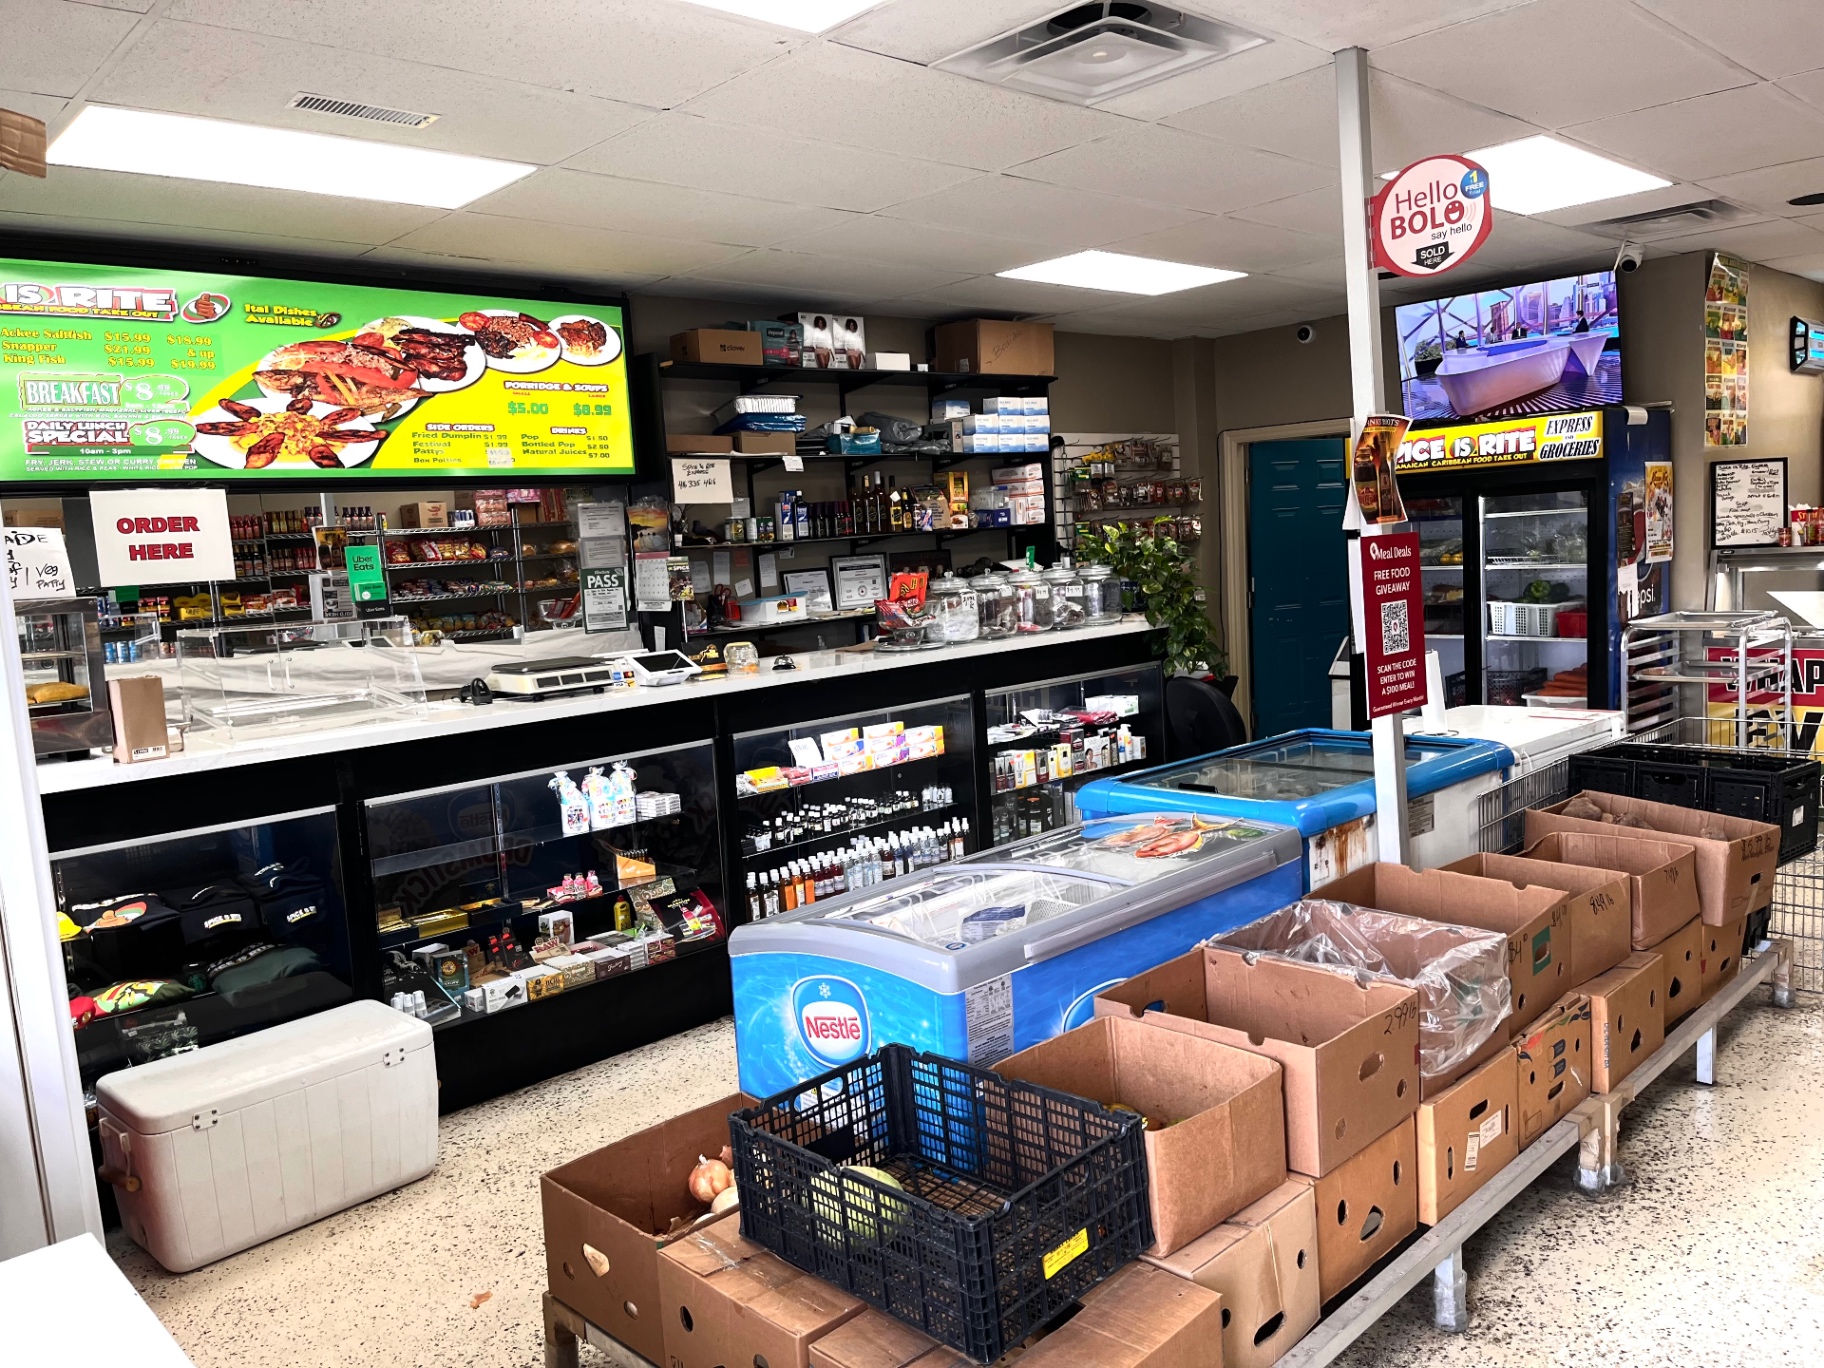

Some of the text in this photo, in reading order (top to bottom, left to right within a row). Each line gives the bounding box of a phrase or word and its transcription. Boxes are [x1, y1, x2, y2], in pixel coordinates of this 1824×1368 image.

[1469, 171, 1479, 183] 1
[1465, 181, 1484, 192] FREE
[1396, 180, 1458, 214] Hello
[1391, 200, 1465, 240] BOLO
[1431, 222, 1473, 241] say hello
[1420, 245, 1446, 260] SOLD
[1424, 256, 1442, 266] HERE
[5, 284, 174, 312] IS RITE
[48, 306, 159, 319] FOOD TAKE OUT
[245, 303, 317, 318] Ital Dishes
[245, 314, 314, 328] Available
[1, 328, 213, 347] Ackee Saltfish $15.99 $18.99
[2, 341, 215, 361] Snapper $21.99 & up
[4, 354, 217, 371] King Fish $15.99 $19.99
[25, 380, 120, 405] BREAKFAST
[504, 381, 561, 392] PORRIDGE
[574, 384, 609, 393] SOUPS
[507, 401, 549, 415] $5.00
[27, 421, 126, 431] DAILY LUNCH
[426, 423, 494, 432] SIDE ORDERS
[1545, 416, 1594, 436] EXPRESS
[28, 430, 128, 443] SPECIAL
[411, 432, 438, 440] Fried
[441, 432, 483, 441] Dumplin
[112, 448, 131, 456] 3pm
[413, 448, 445, 456] Pattys
[1396, 428, 1537, 463] ICE IS RITE
[1539, 438, 1600, 461] GROCERIES
[1431, 457, 1474, 468] CARIBBEAN
[1473, 456, 1493, 464] FOOD
[1493, 454, 1513, 463] TAKE
[1513, 453, 1528, 461] OUT
[116, 516, 201, 534] ORDER
[128, 542, 194, 561] HERE
[352, 555, 373, 563] Uber
[1377, 545, 1412, 561] Meal Deals
[353, 563, 375, 571] Eats
[1374, 566, 1411, 581] FREE FOOD
[587, 574, 619, 589] PASS
[1375, 580, 1411, 596] GIVEAWAY
[1377, 657, 1418, 675] SCAN THE CODE
[1380, 669, 1416, 685] ENTER TO WIN
[1381, 686, 1387, 696] A
[535, 938, 560, 954] RAW
[805, 1014, 861, 1041] Nestlé
